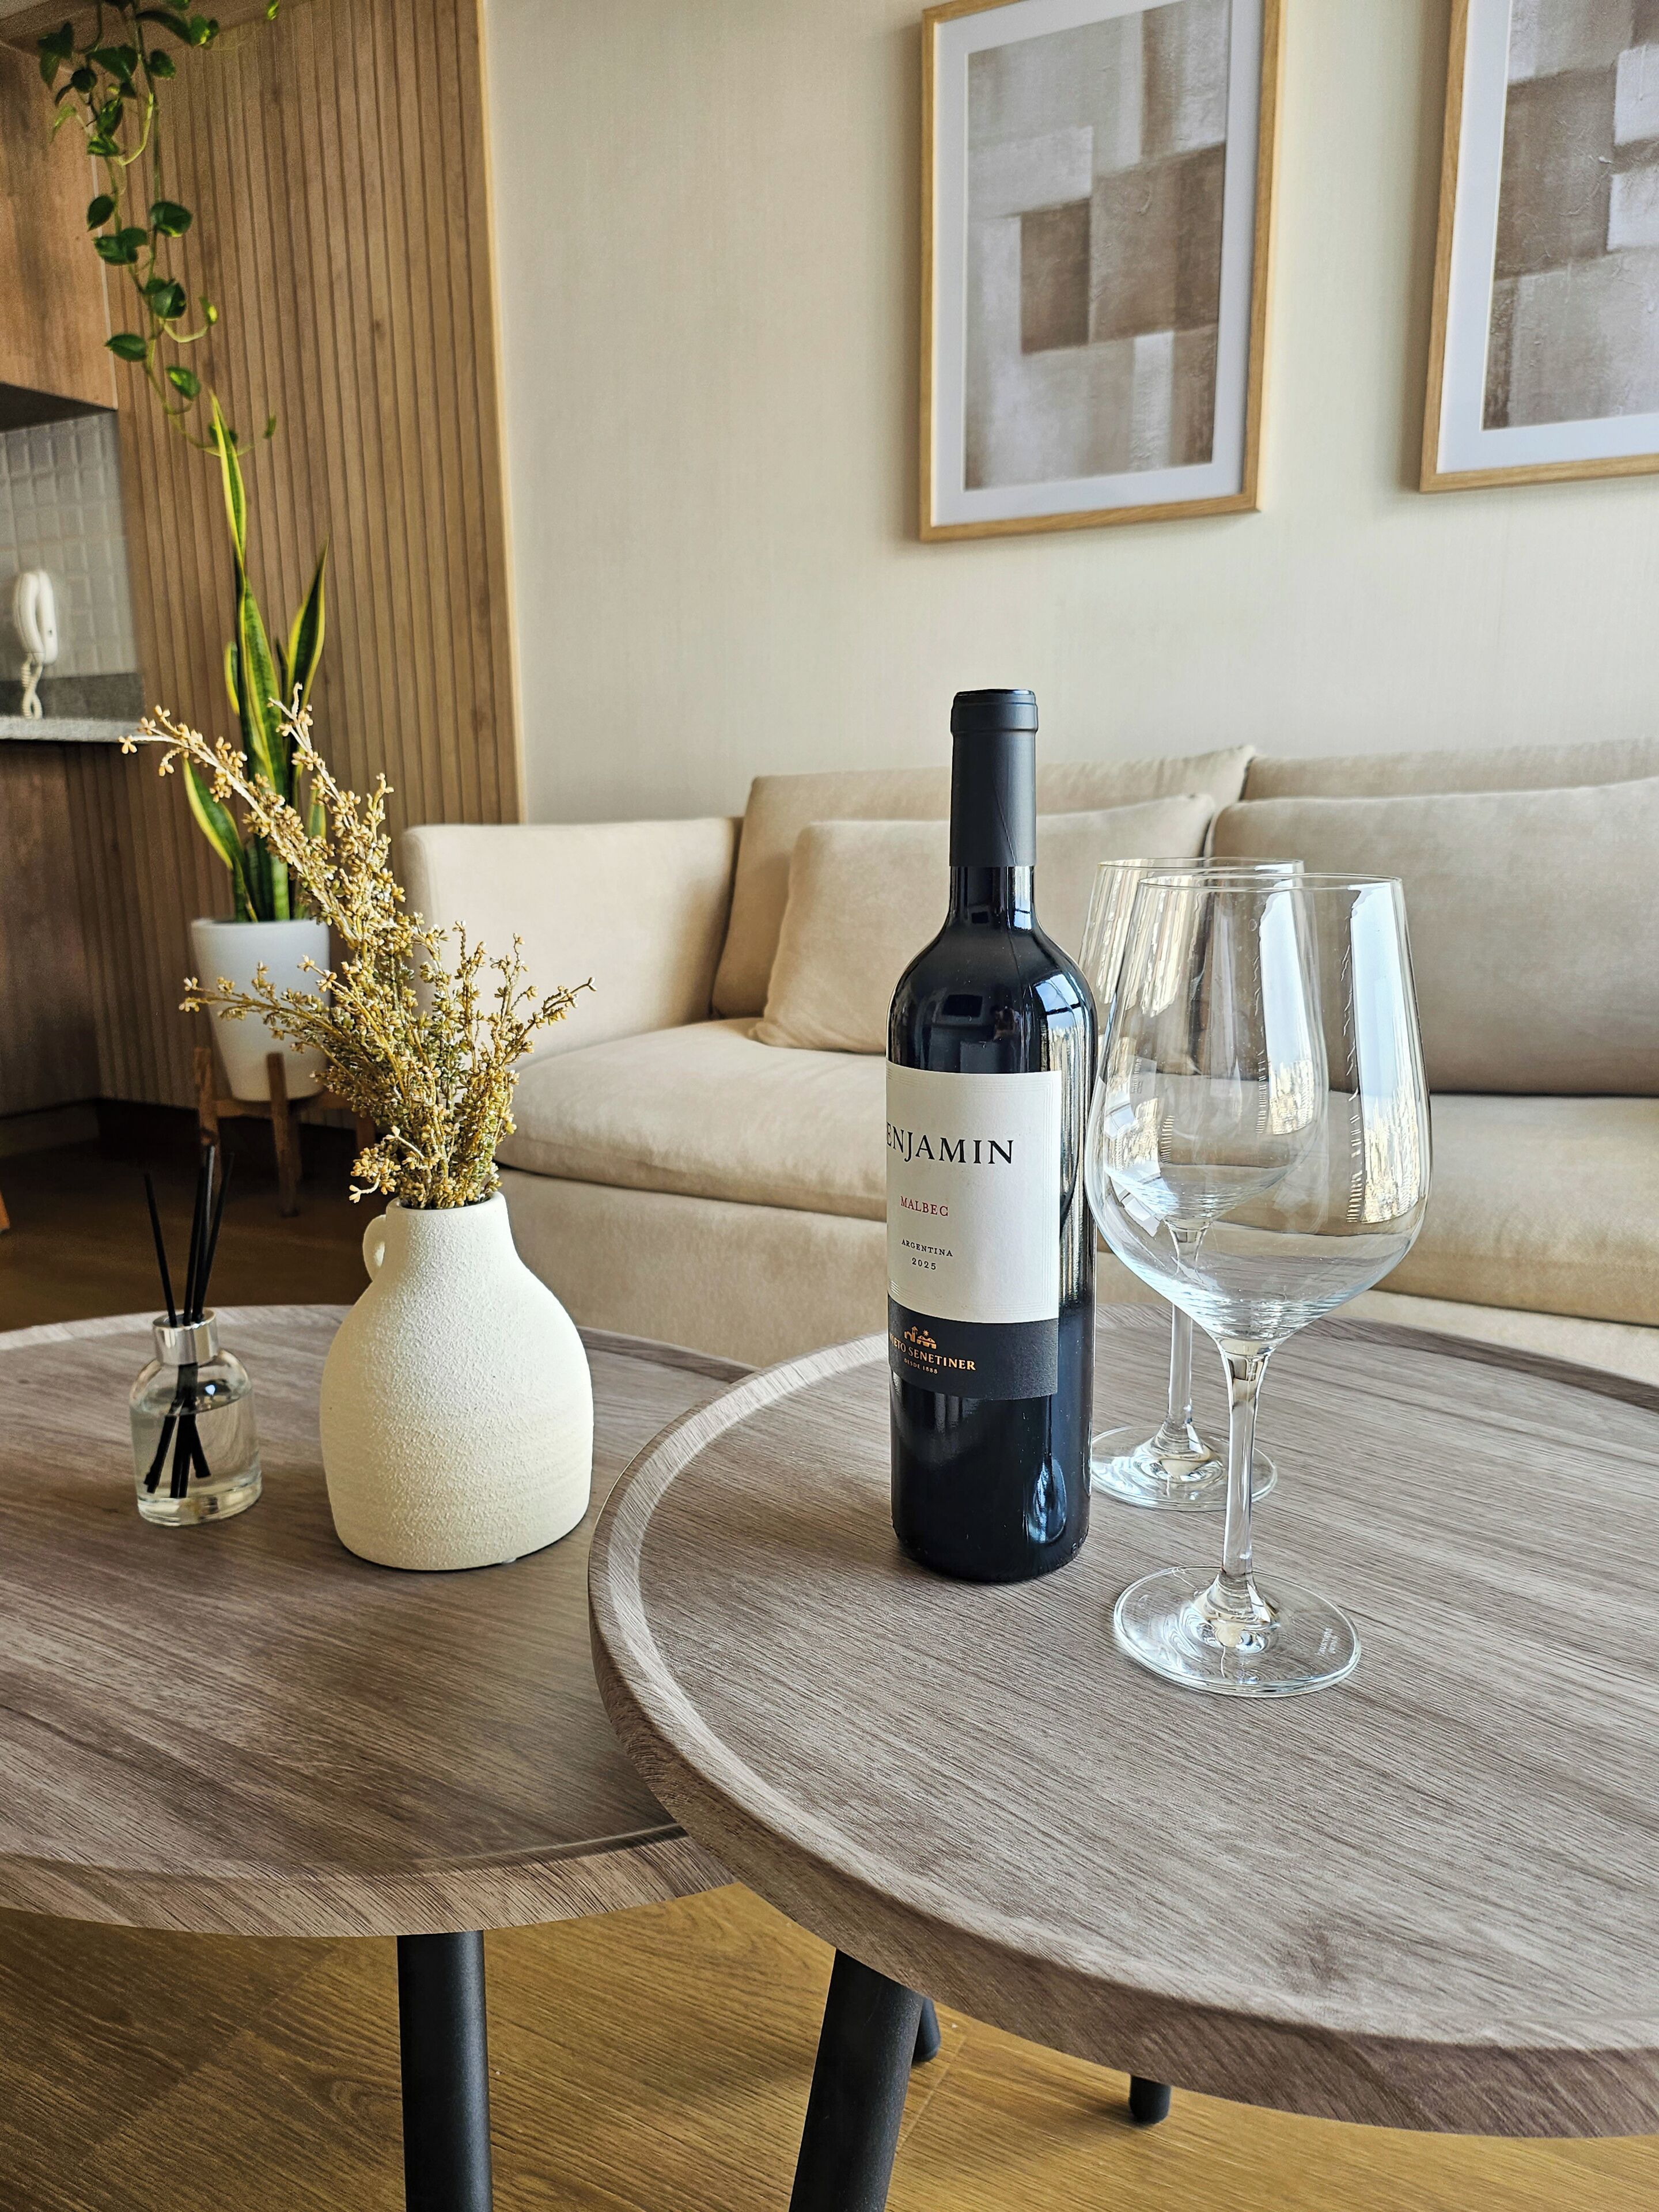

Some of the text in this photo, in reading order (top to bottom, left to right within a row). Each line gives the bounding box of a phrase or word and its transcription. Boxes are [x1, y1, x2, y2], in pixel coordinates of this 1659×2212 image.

[887, 1122, 1014, 1164] ENJAMIN
[900, 1195, 949, 1217] MALBEC
[902, 1238, 953, 1257] ARGENTINA
[912, 1257, 936, 1270] 2025
[908, 1346, 976, 1370] SENETINER
[922, 1365, 938, 1374] 1888
